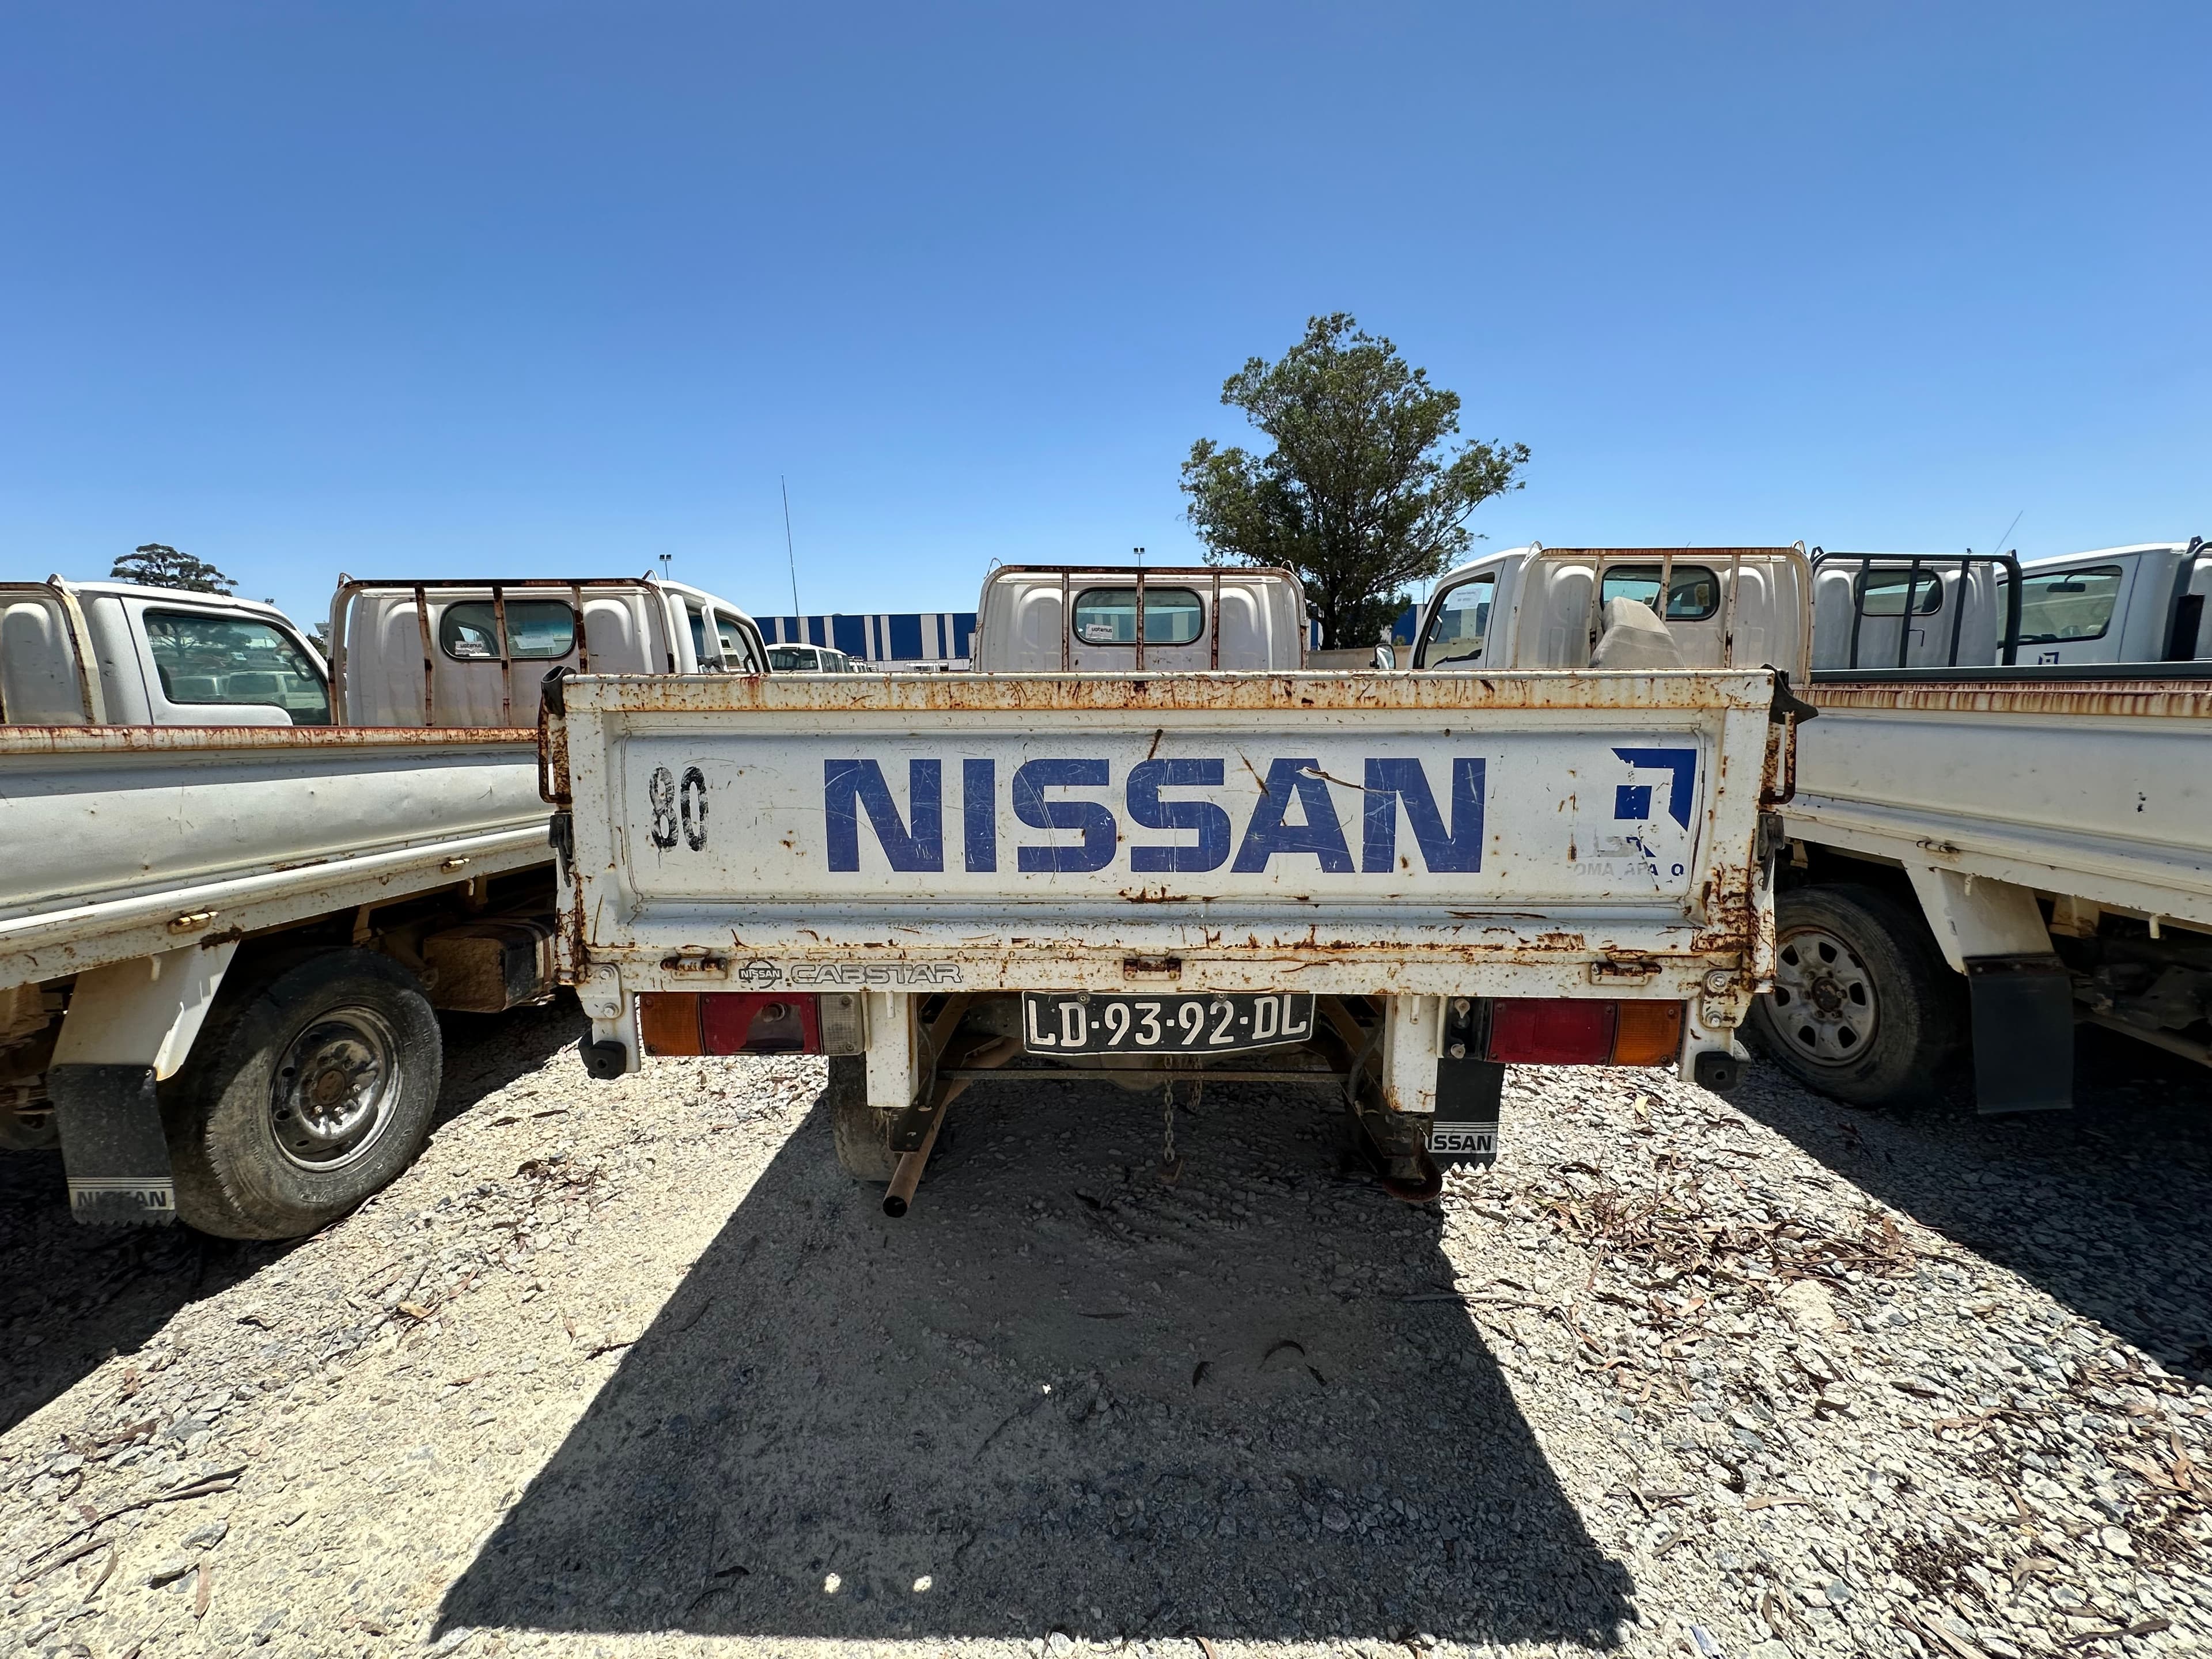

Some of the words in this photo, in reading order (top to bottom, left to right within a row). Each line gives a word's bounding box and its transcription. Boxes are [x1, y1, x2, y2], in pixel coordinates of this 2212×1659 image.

[649, 767, 709, 852] 80
[824, 758, 1487, 873] NISSAN
[740, 969, 781, 979] NISSAN
[790, 964, 963, 984] CABSTAR
[1427, 1135, 1492, 1150] ISSAN
[77, 1191, 166, 1207] NAN
